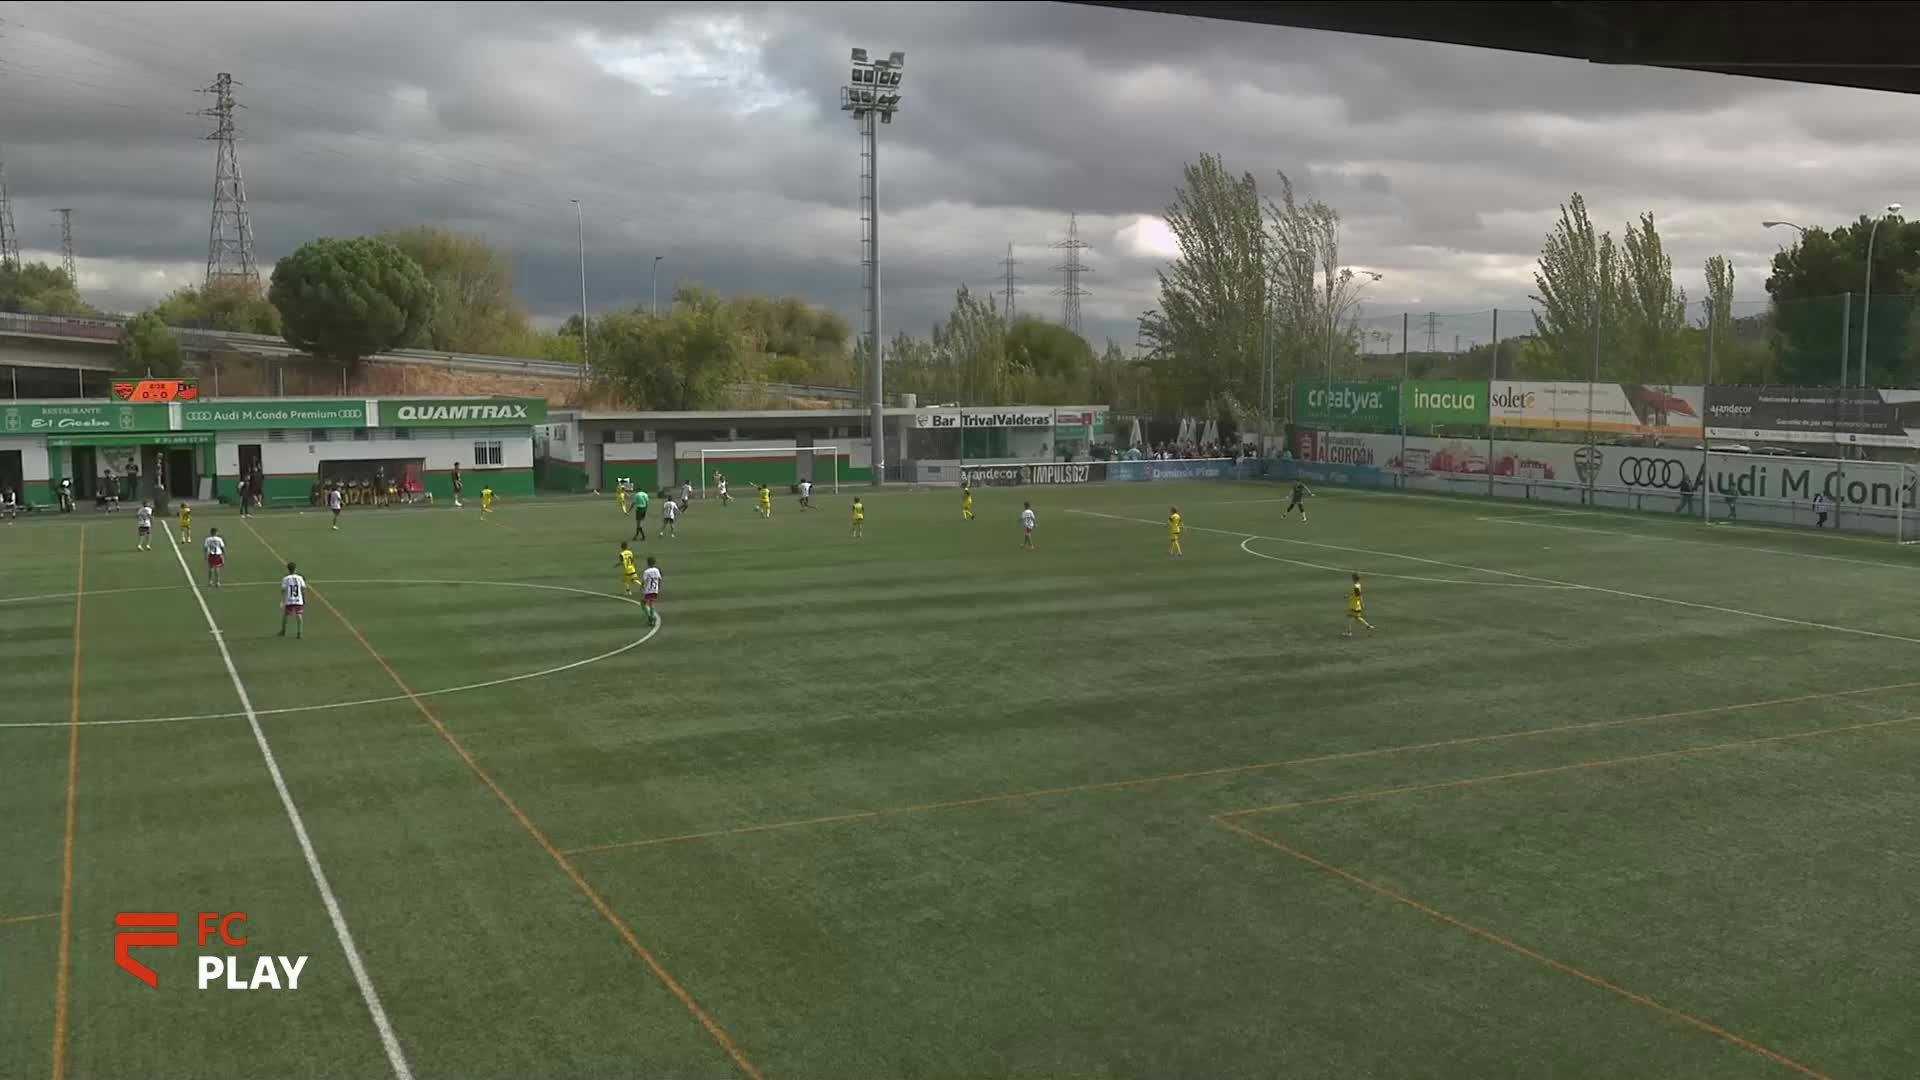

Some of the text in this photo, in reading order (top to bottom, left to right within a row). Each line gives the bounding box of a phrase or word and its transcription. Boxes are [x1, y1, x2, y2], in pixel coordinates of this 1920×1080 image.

[1414, 388, 1475, 410] inacua
[214, 409, 337, 421] Audi M.Conde Premium
[398, 405, 528, 420] QUAMTRAX
[31, 418, 53, 428] El
[932, 415, 956, 427] Bar
[1692, 463, 1767, 497] Audi
